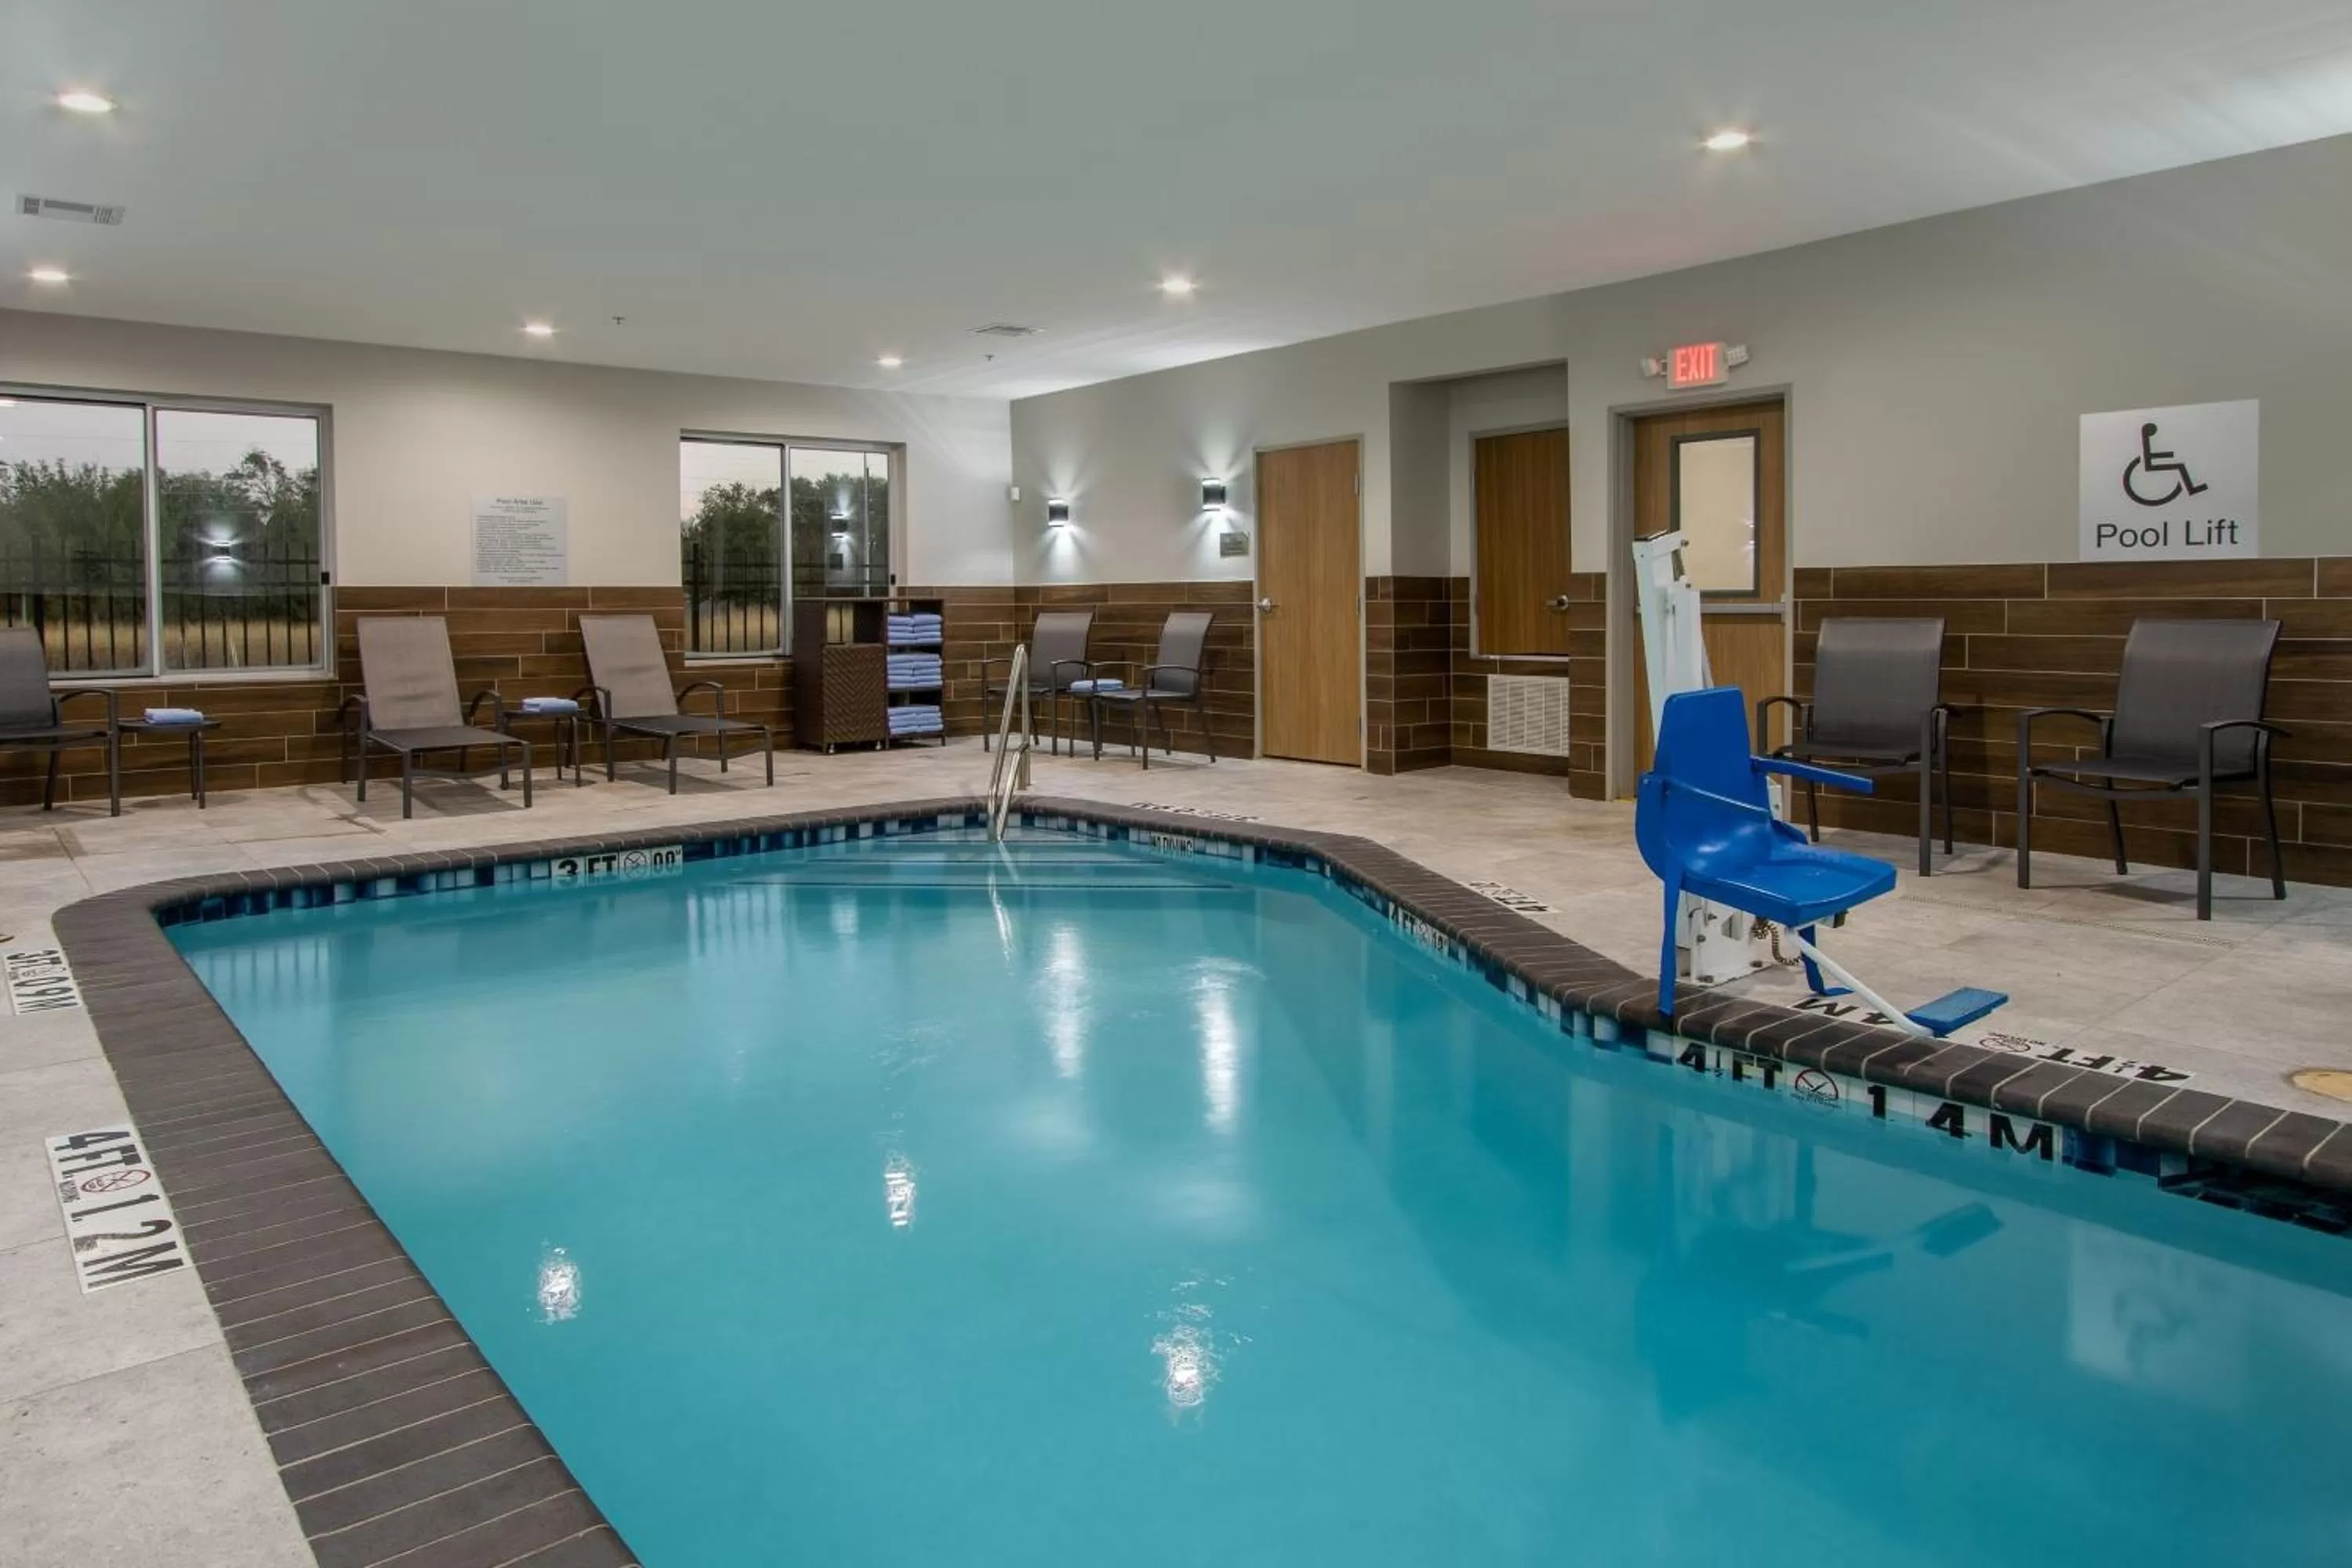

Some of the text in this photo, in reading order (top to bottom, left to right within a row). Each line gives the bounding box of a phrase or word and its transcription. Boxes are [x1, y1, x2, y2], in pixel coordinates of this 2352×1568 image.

[1675, 344, 1715, 382] EXIT
[2096, 518, 2239, 548] Pool Lift
